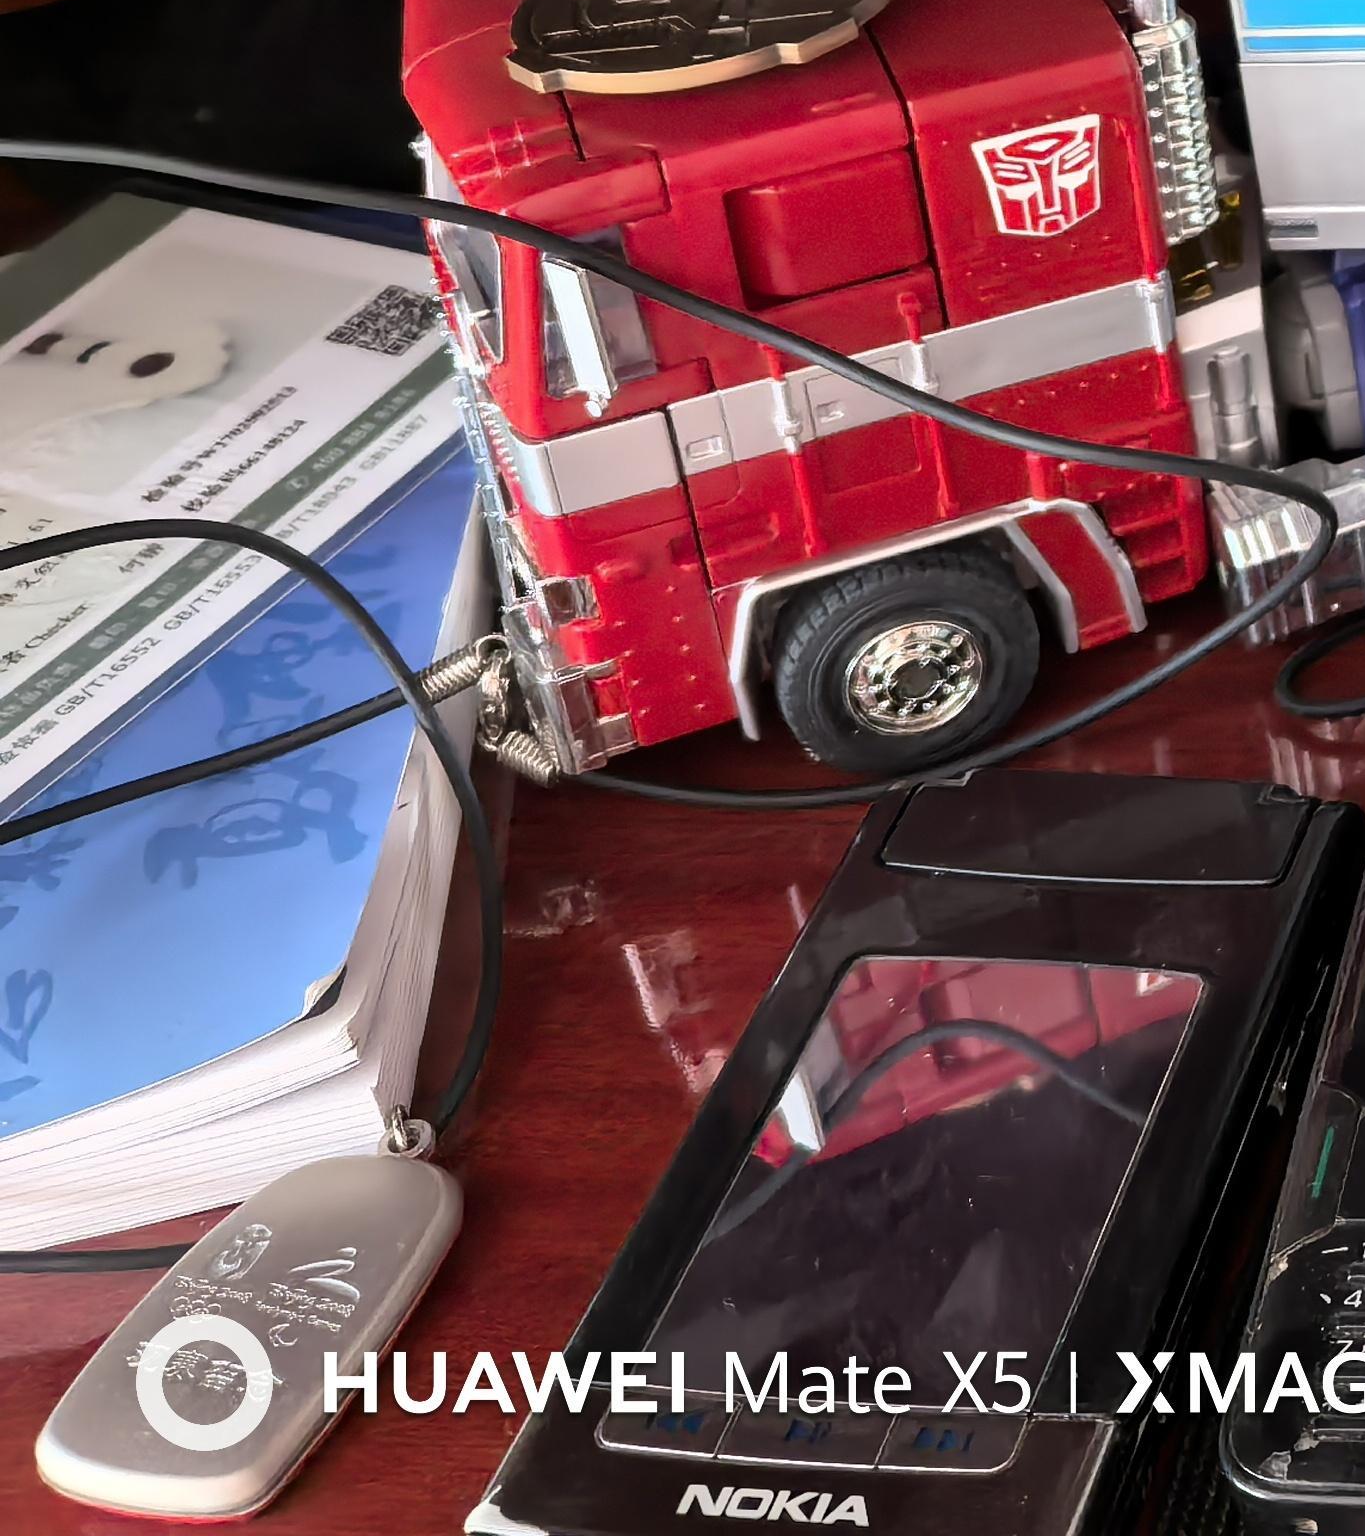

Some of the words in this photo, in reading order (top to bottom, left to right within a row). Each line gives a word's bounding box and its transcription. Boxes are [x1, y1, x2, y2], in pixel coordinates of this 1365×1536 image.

[54, 636, 162, 716] GB/T16552
[1344, 1290, 1362, 1307] 4
[675, 1482, 872, 1528] NOKIA
